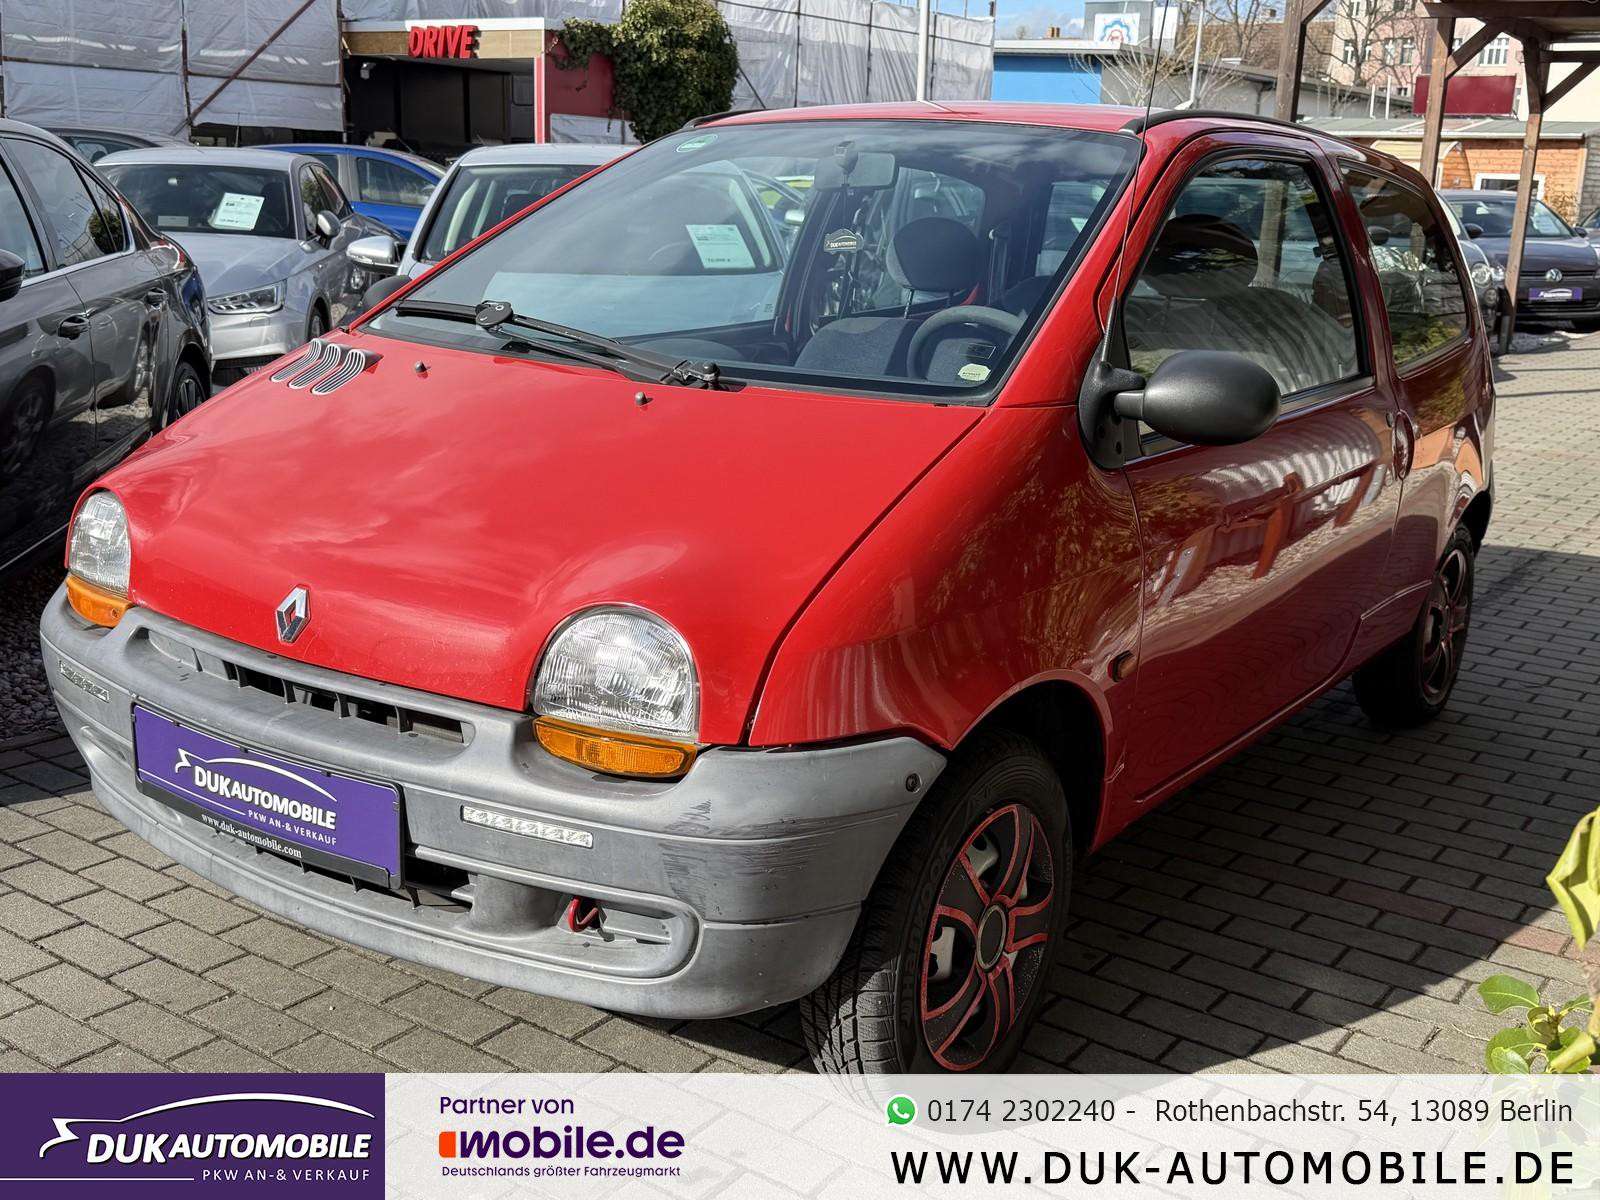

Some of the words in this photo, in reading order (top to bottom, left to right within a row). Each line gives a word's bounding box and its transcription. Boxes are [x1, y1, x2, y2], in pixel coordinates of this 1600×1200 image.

[408, 25, 476, 58] DRIVE
[201, 813, 302, 859] www.duk-automobile.com
[248, 809, 267, 824] PKW
[294, 825, 337, 846] VERKAUF
